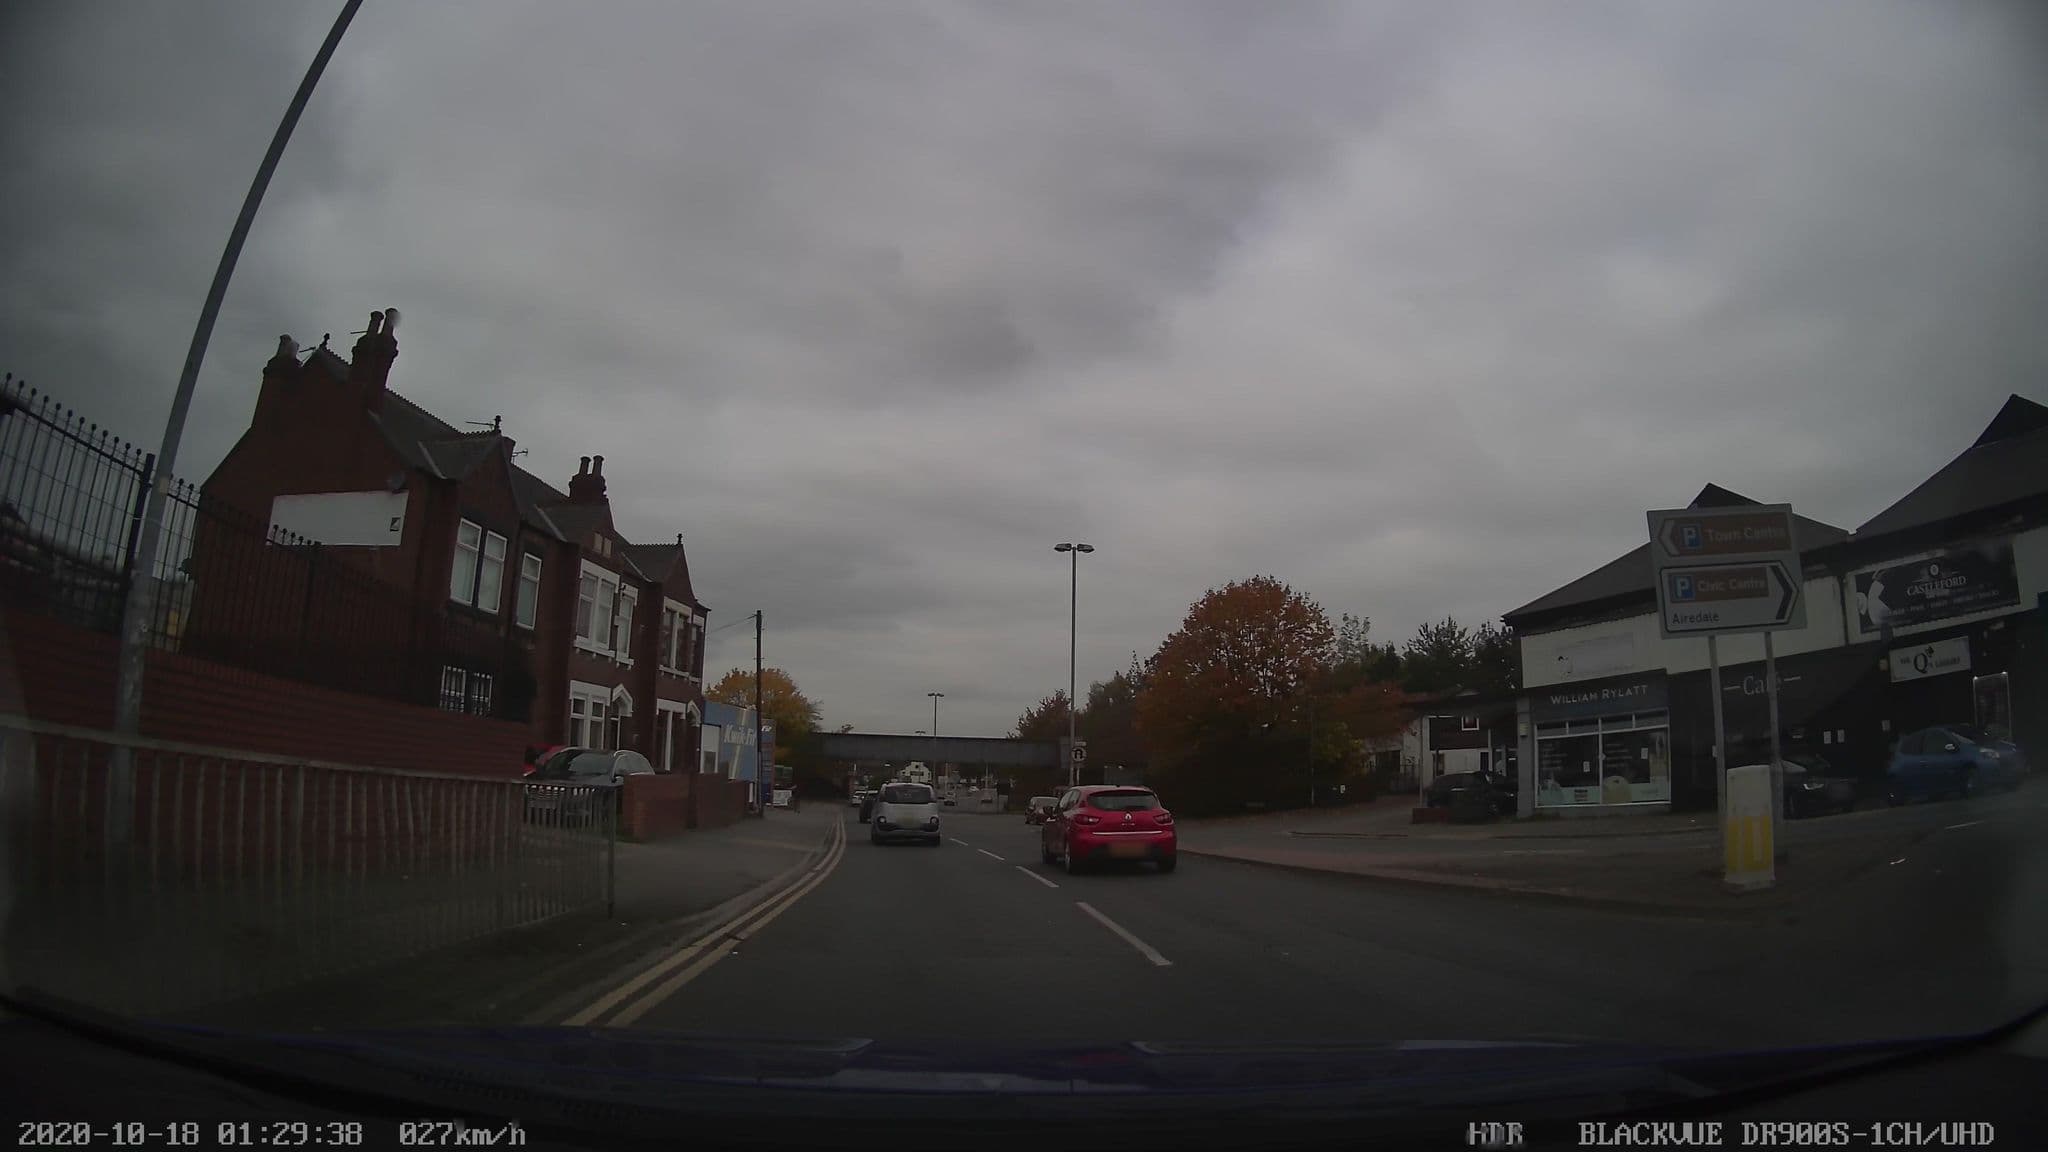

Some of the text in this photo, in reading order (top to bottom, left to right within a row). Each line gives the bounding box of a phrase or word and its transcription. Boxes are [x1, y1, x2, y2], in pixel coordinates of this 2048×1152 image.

[1706, 528, 1742, 544] Town
[1907, 575, 1967, 597] CASTLEFORD
[1672, 610, 1721, 625] Airedale
[1550, 685, 1649, 705] WILLIAM RYLATT
